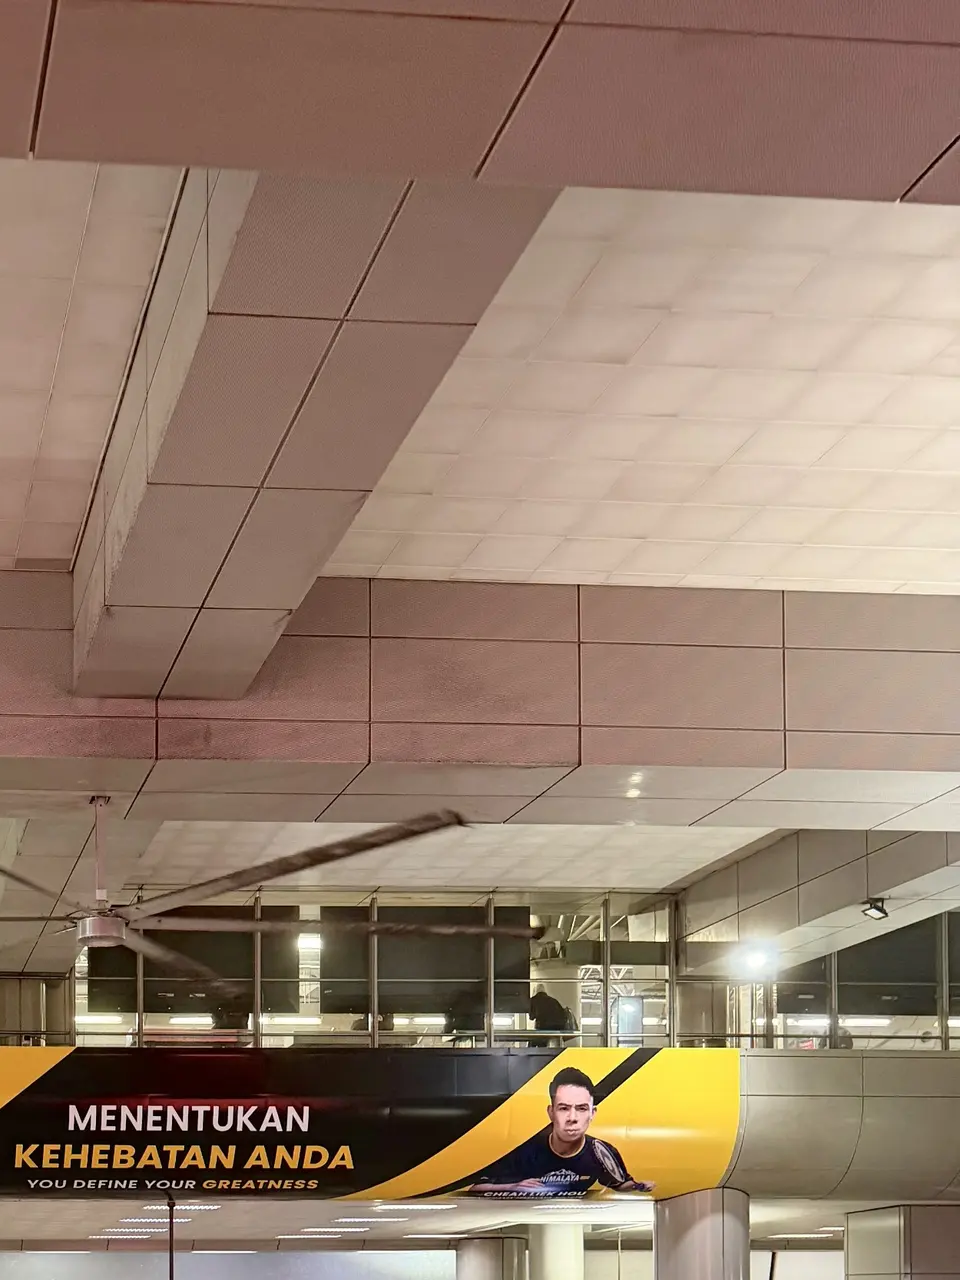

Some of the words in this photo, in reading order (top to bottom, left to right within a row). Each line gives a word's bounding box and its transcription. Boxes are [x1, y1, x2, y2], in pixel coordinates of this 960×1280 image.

[68, 1105, 310, 1132] MENENTUKAN
[14, 1144, 237, 1169] KEHEBATAN
[243, 1144, 355, 1170] ANDA
[27, 1179, 67, 1189] YOU
[73, 1179, 138, 1189] DEFINE
[145, 1179, 196, 1189] YOUR
[202, 1179, 319, 1189] GREATNESS
